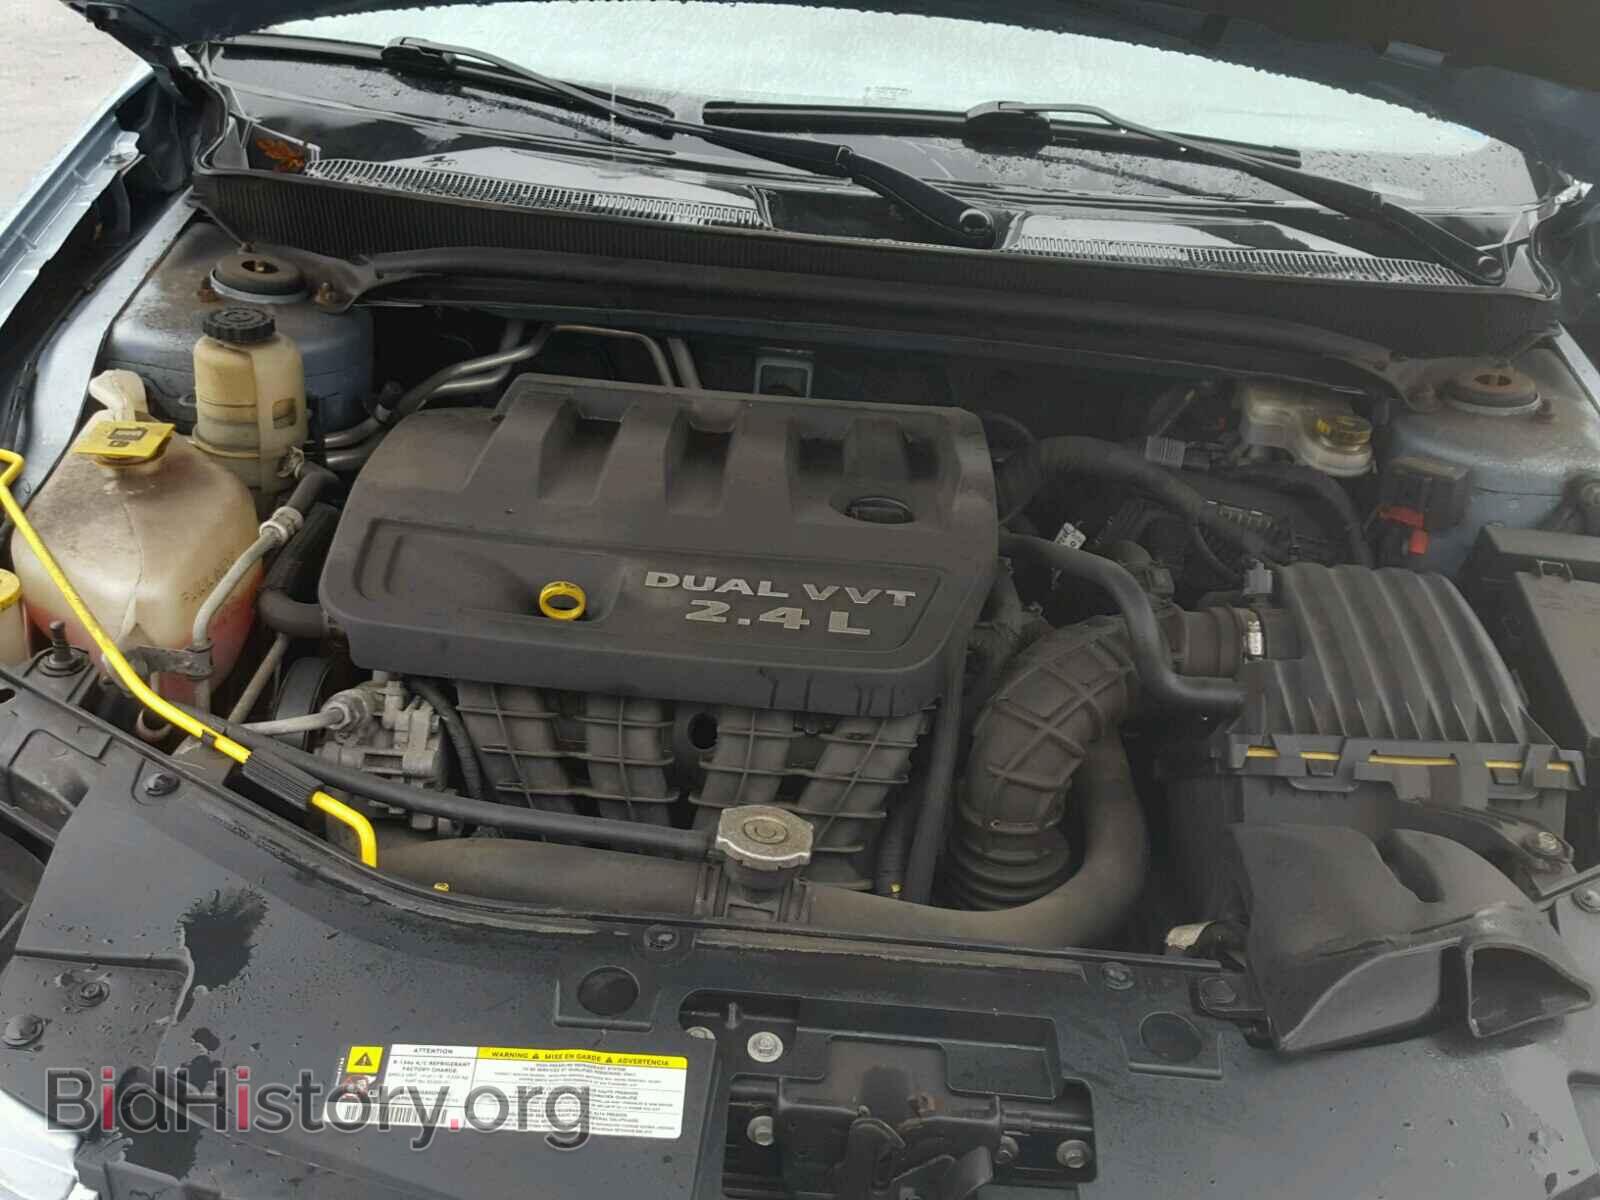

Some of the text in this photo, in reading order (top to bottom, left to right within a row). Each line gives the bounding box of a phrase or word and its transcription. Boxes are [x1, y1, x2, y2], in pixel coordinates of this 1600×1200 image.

[644, 571, 917, 607] DUAL VVT
[413, 1047, 454, 1055] ATTENTION
[491, 1051, 529, 1060] WARNING
[576, 1053, 601, 1062] GARDE
